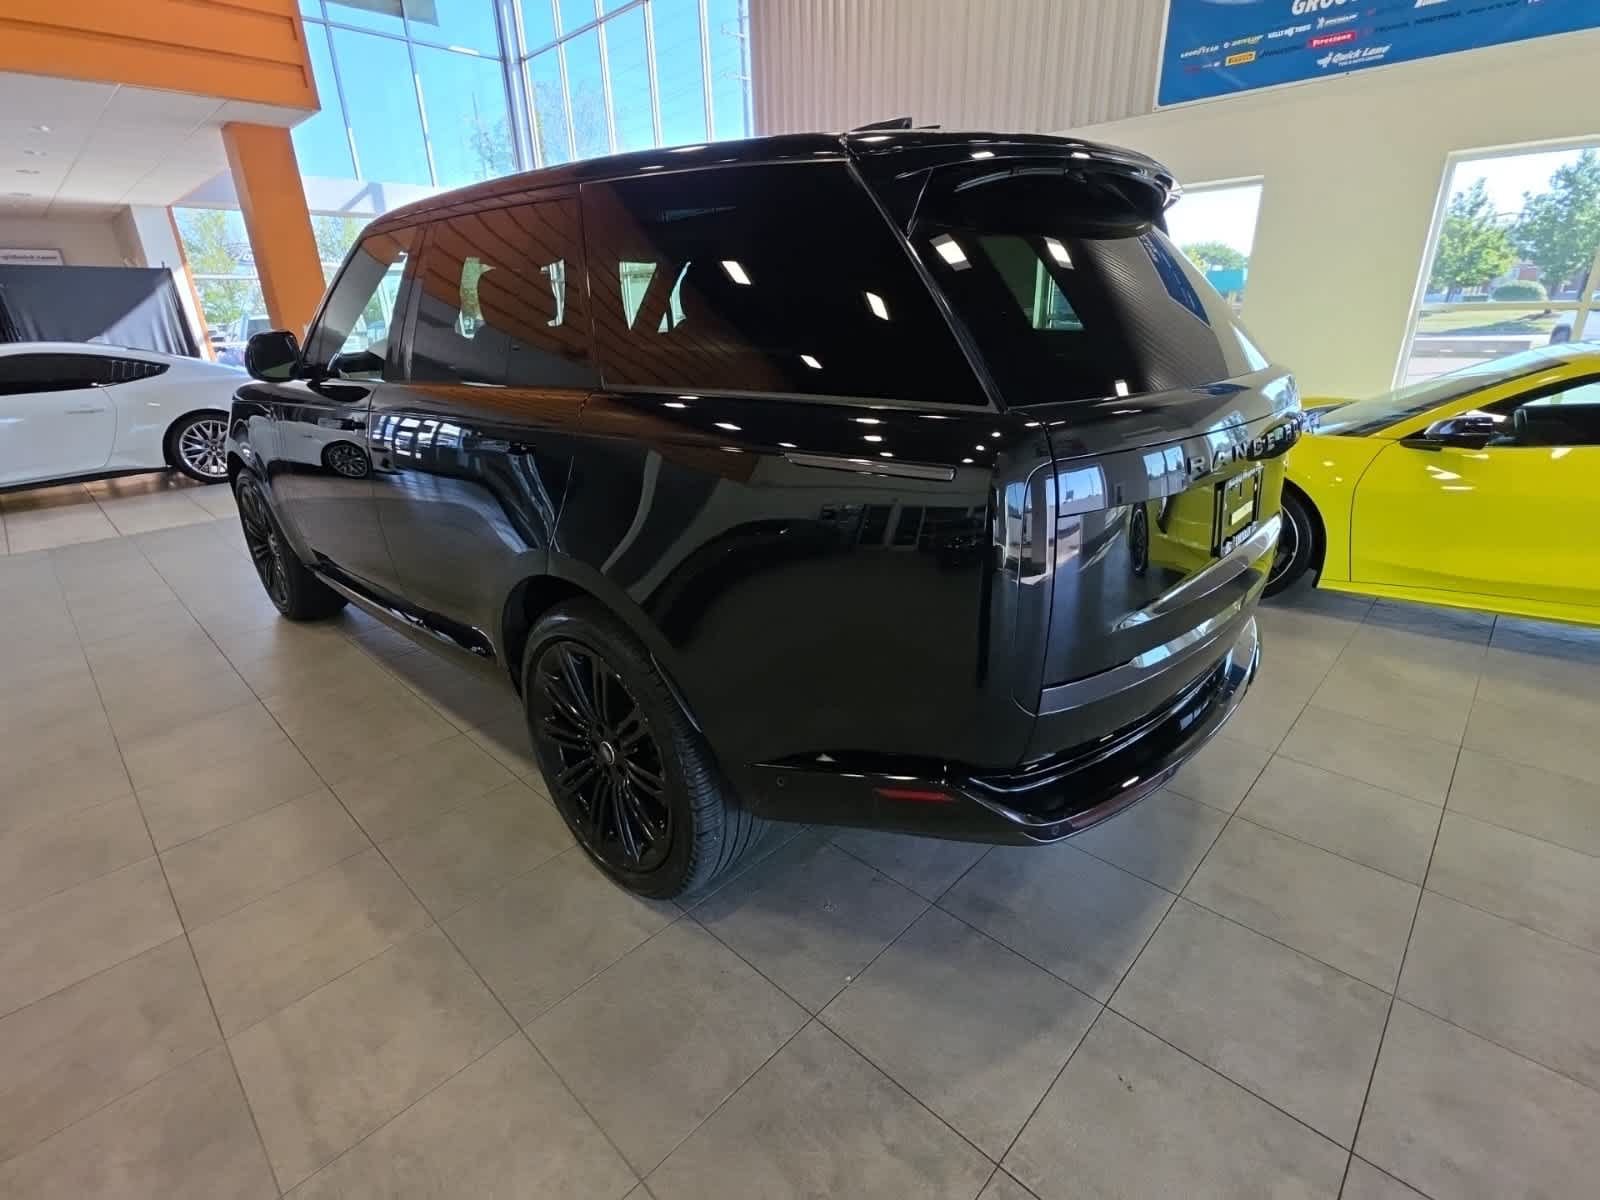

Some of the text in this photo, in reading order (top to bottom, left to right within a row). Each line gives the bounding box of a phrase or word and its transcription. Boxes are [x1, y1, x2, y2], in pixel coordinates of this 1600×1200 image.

[1292, 0, 1359, 15] GRO
[1332, 47, 1361, 63] Quick
[1186, 432, 1276, 475] RANGE
